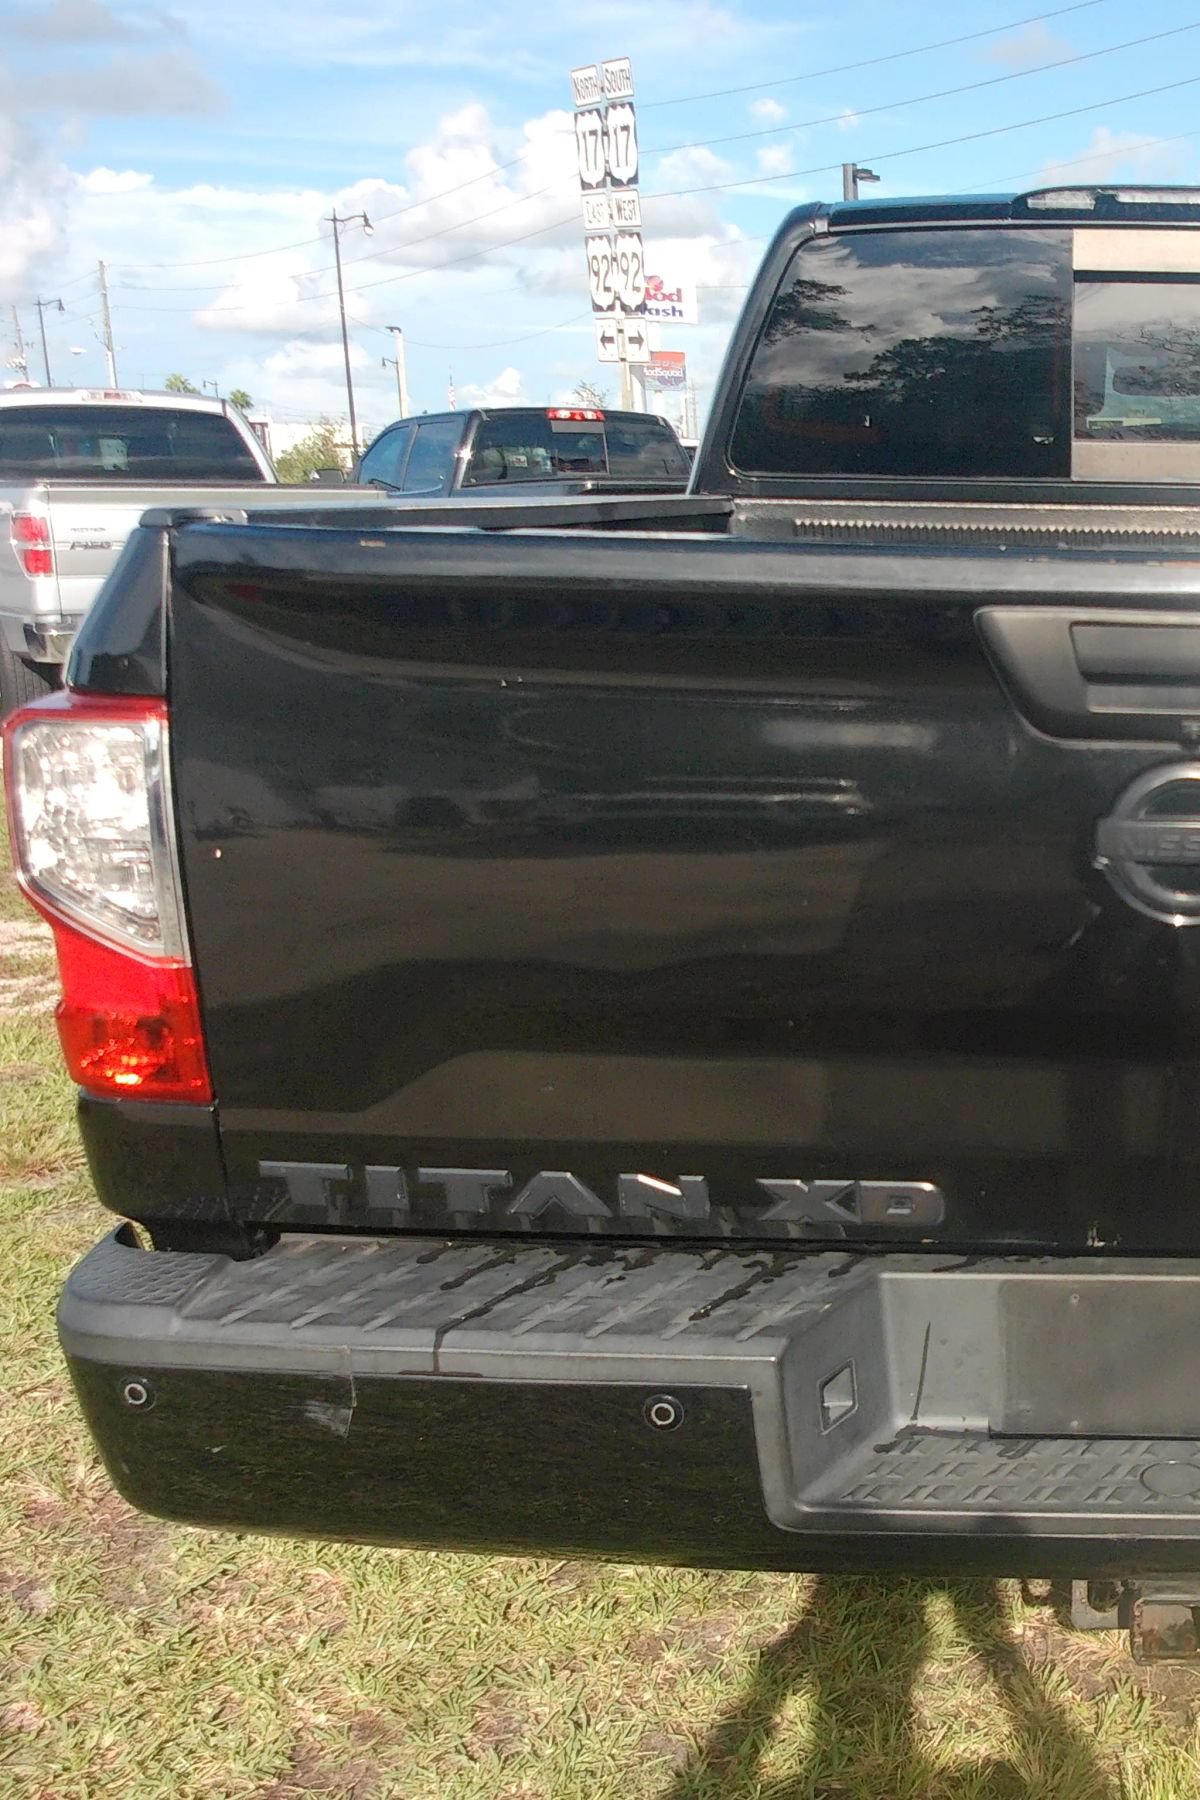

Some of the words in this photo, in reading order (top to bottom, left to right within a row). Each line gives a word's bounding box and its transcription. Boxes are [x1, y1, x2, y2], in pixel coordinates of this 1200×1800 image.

[573, 76, 600, 100] NORTH
[604, 68, 632, 93] SOUTH
[583, 129, 599, 171] 17
[614, 124, 631, 168] 17
[615, 198, 637, 221] WEST
[591, 255, 612, 296] 92
[620, 252, 641, 293] 92
[257, 1160, 712, 1220] TITAN
[755, 1177, 946, 1226] XD
